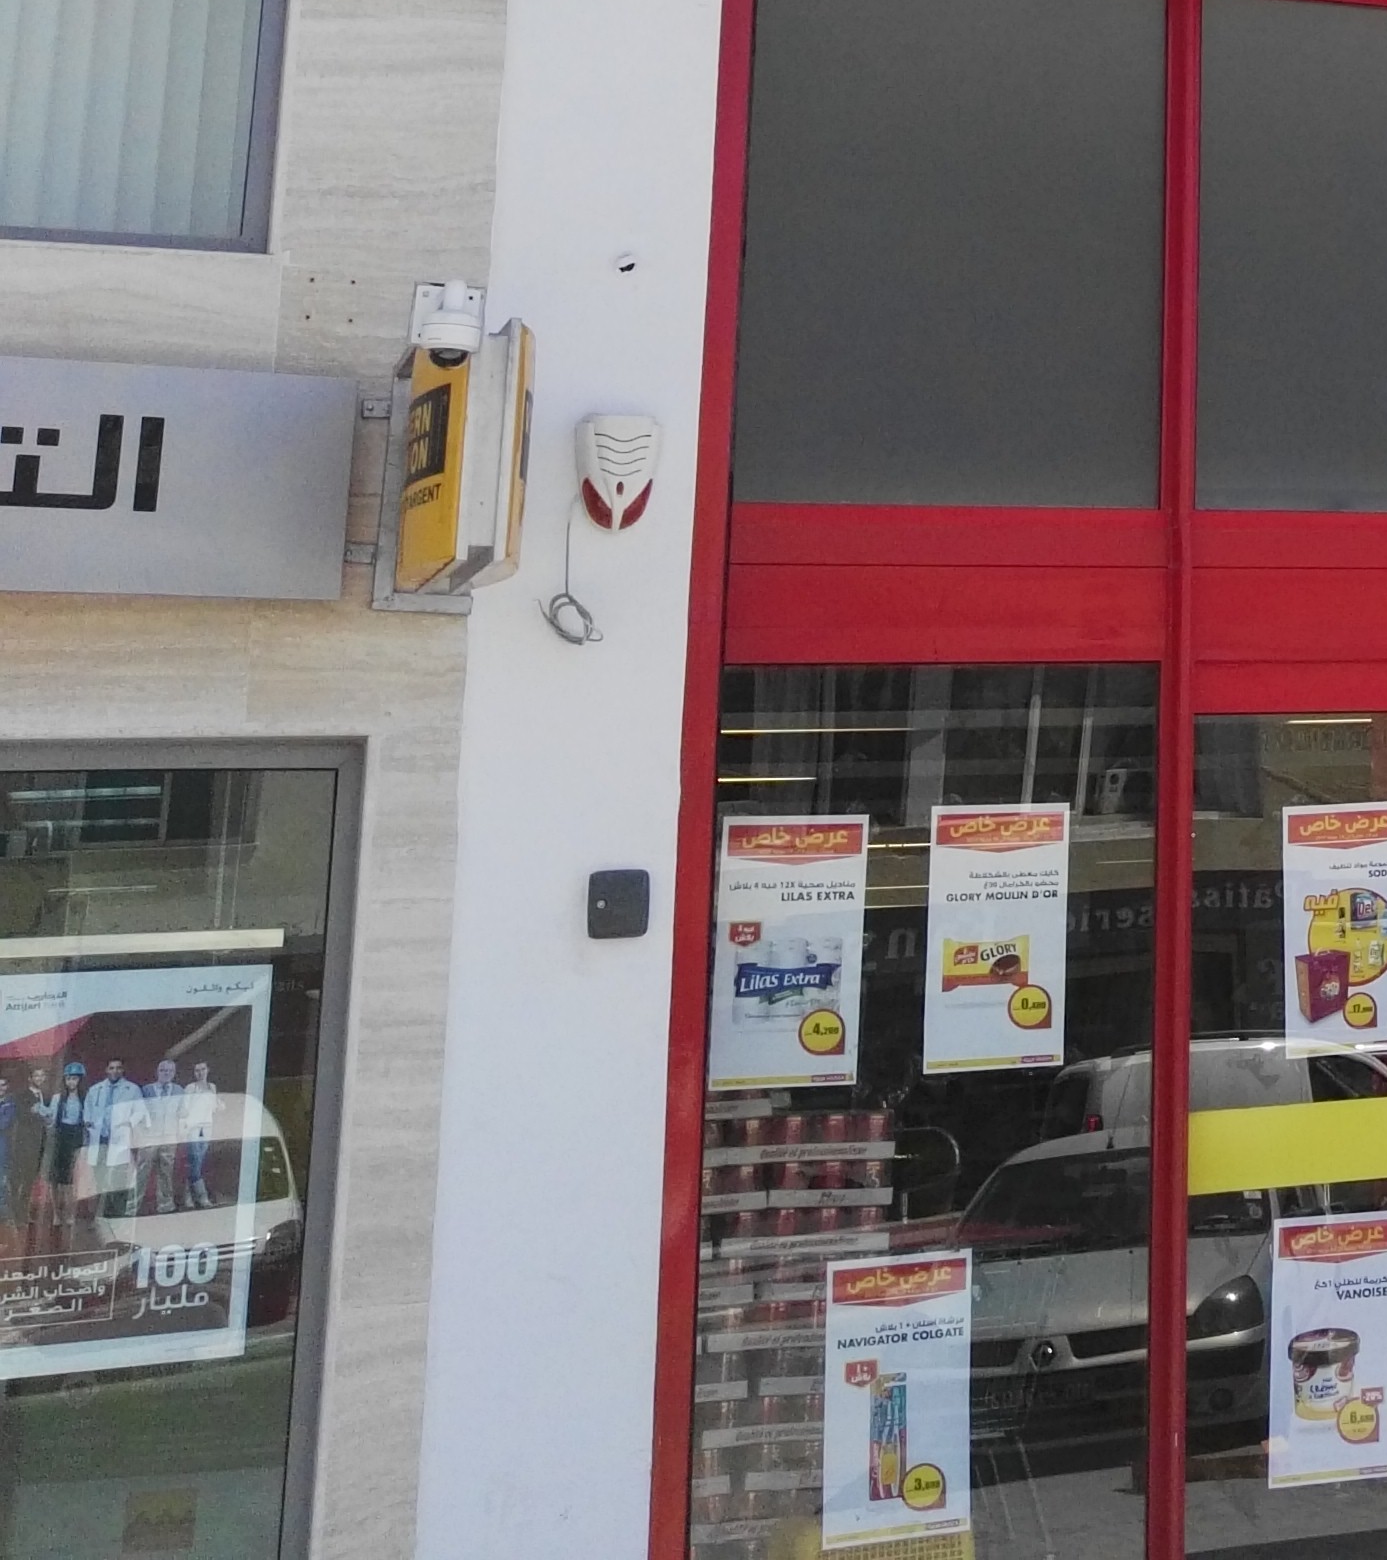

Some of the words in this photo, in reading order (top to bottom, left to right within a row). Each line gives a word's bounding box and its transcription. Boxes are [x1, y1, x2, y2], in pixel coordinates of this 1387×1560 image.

[0, 414, 165, 512] الت
[950, 815, 996, 838] خاص
[1000, 817, 1050, 836] عرض
[1300, 814, 1341, 836] خاص
[742, 826, 791, 848] خاص
[795, 828, 849, 847] عرض
[781, 891, 813, 902] LILAS
[817, 891, 855, 901] EXTRA
[946, 893, 981, 902] GLORY
[985, 891, 1028, 901] MOULIN
[1032, 890, 1059, 899] D'OR
[980, 943, 1017, 961] GLORY
[740, 974, 779, 993] Lilas
[783, 973, 820, 987] Extra
[1291, 1225, 1334, 1250] خاص
[1338, 1225, 1384, 1245] عرض
[0, 1266, 48, 1282] المهن
[129, 1241, 219, 1289] 100
[847, 1267, 895, 1293] خاص
[900, 1265, 952, 1289] عرض
[0, 1286, 39, 1304] الشر
[132, 1284, 210, 1320] مليار
[837, 1333, 908, 1350] NAVIGATOR
[912, 1326, 964, 1341] COLGATE
